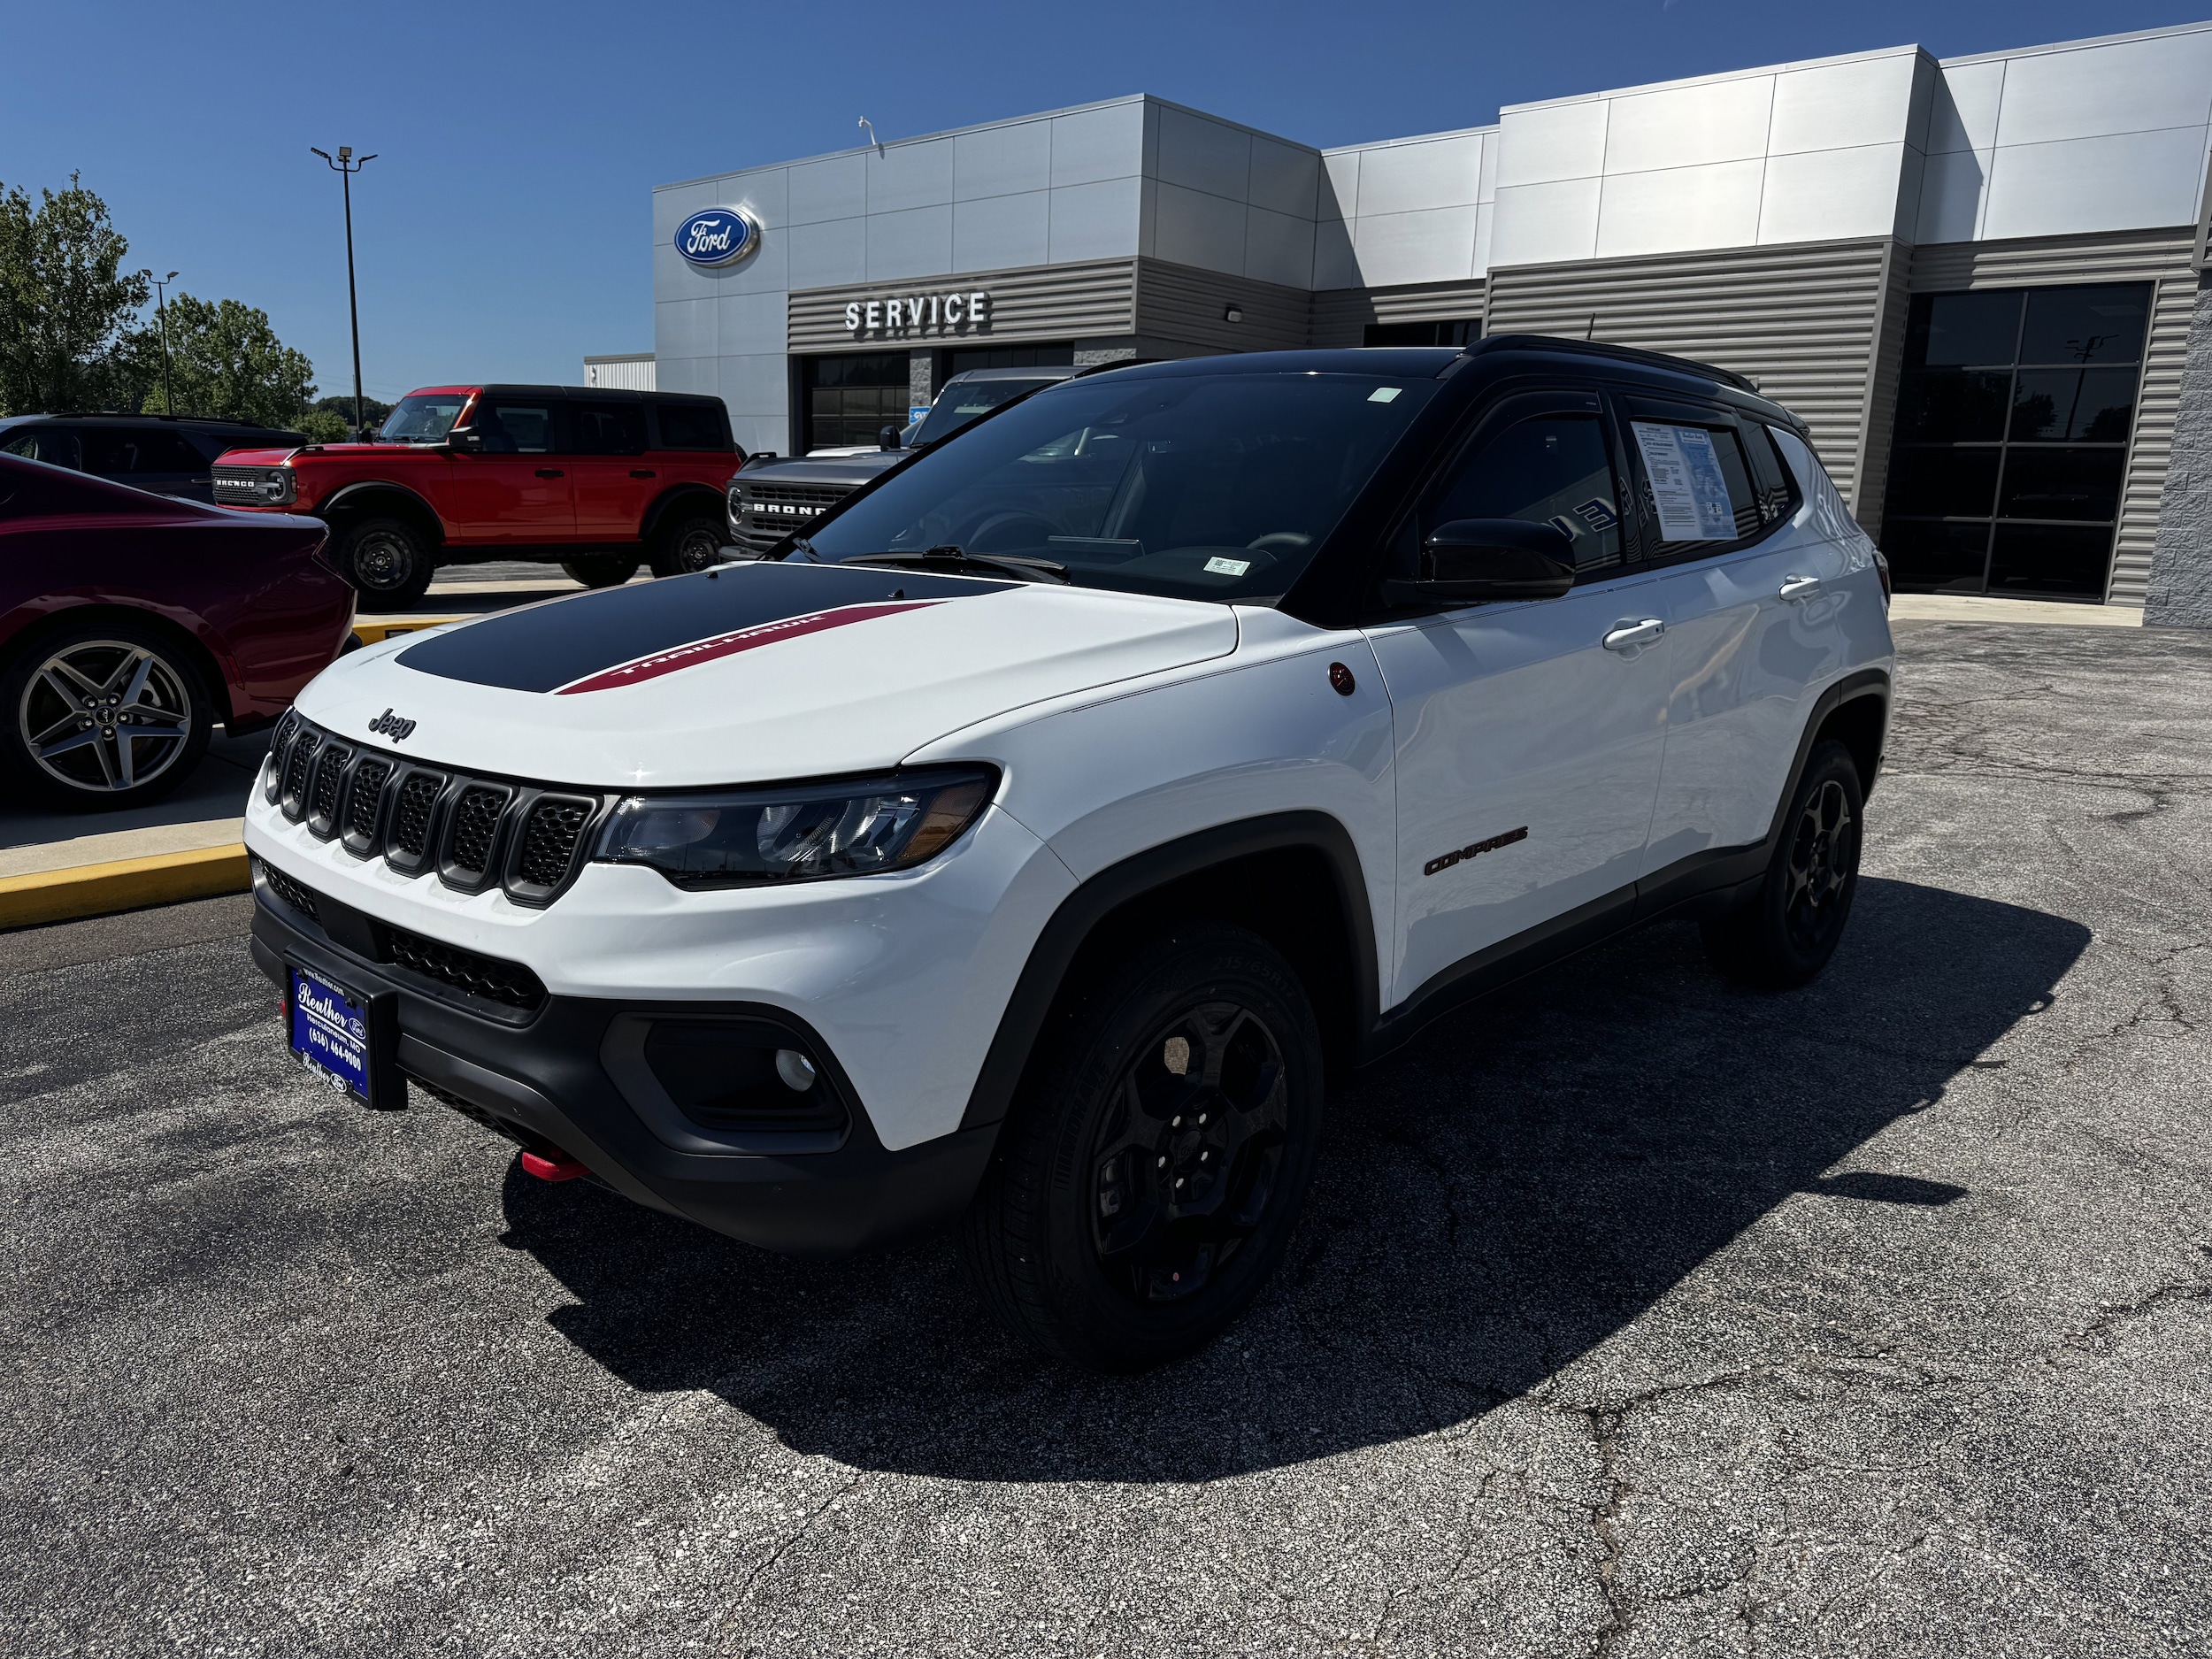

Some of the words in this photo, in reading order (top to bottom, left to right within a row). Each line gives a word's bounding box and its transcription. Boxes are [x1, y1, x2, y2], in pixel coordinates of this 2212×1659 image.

[687, 219, 732, 254] Ford
[845, 291, 986, 331] SERVICE
[753, 503, 827, 516] BRONC
[610, 616, 826, 677] TRAILHAWK
[368, 707, 417, 744] Jeep
[298, 982, 348, 1028] Reuther
[309, 1026, 329, 1053] (636)
[330, 1040, 362, 1072] 464-9000
[349, 1040, 361, 1054] MO
